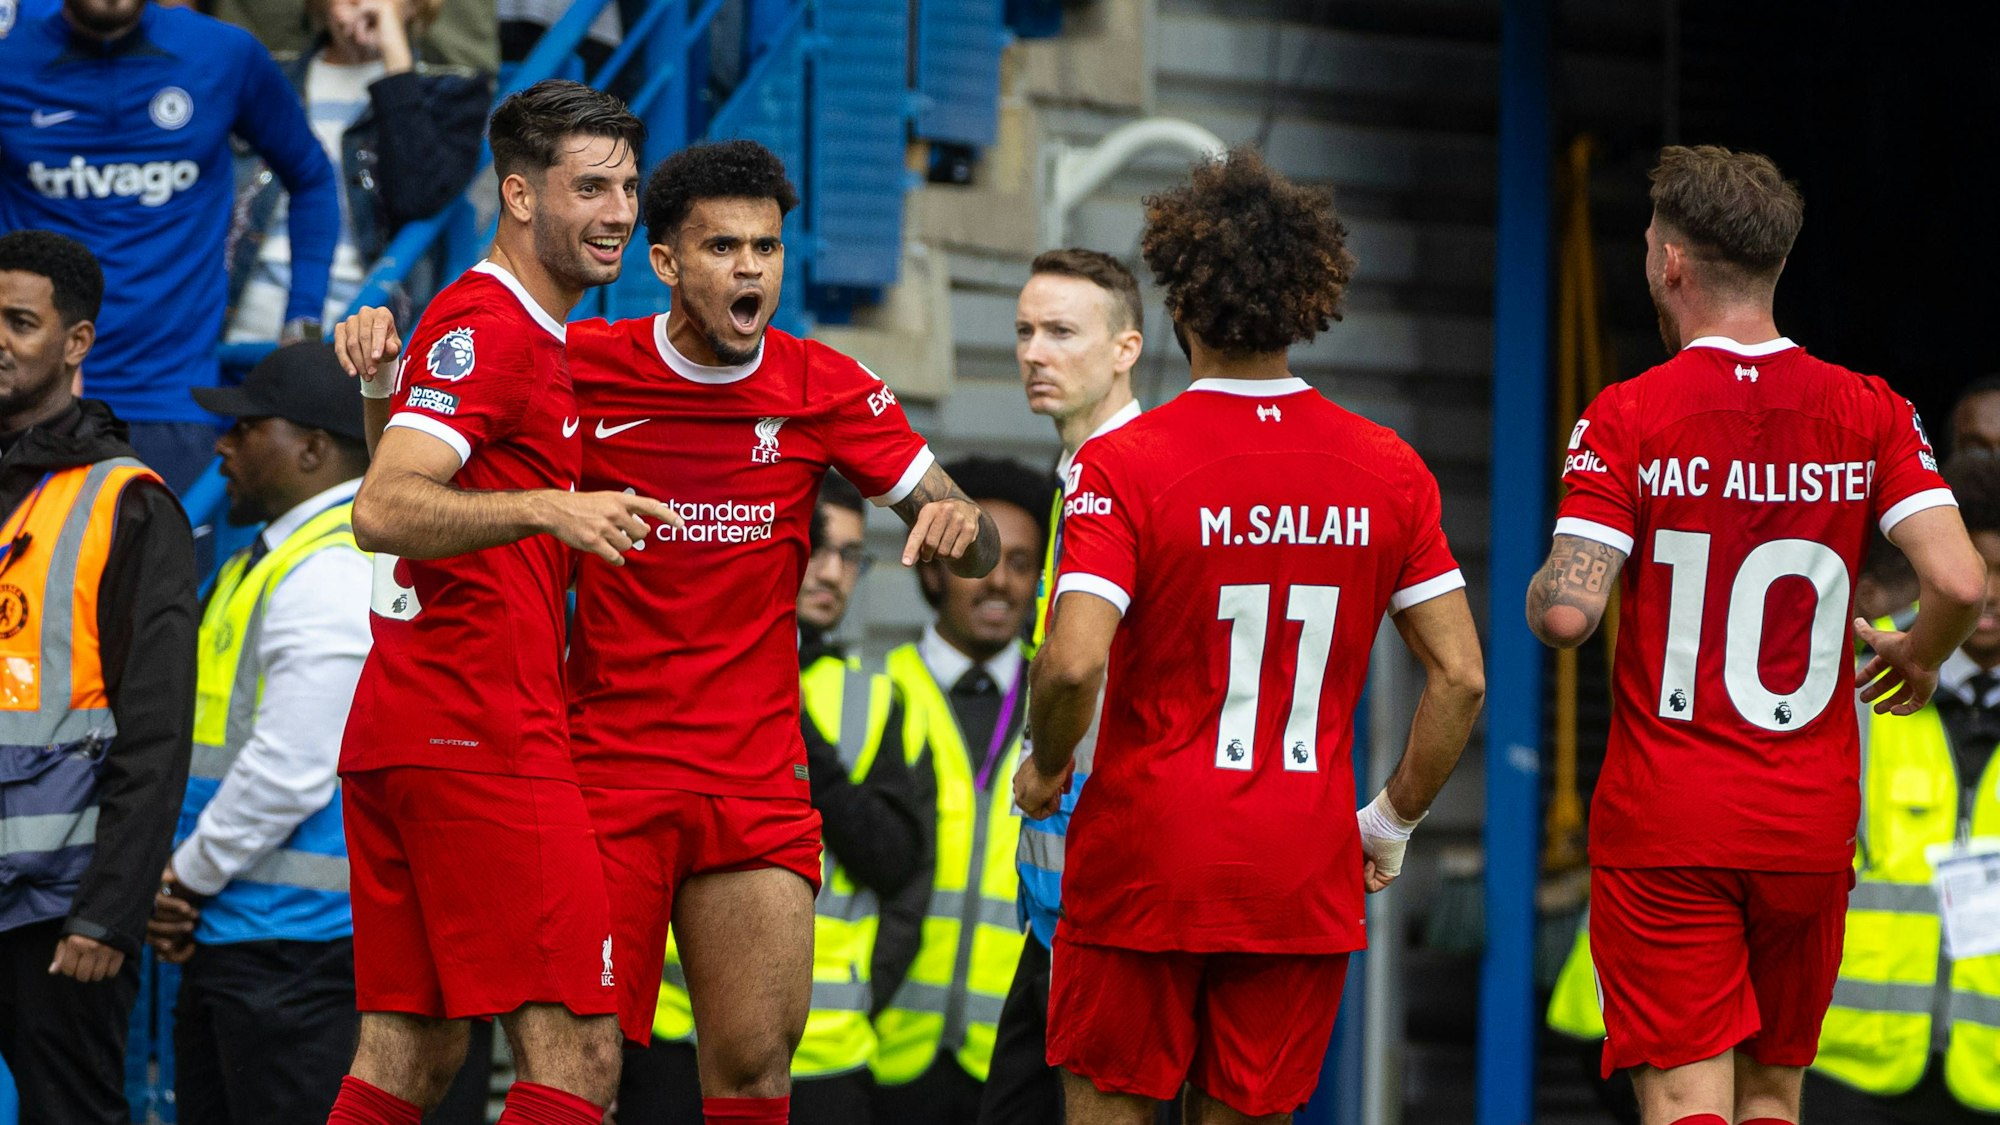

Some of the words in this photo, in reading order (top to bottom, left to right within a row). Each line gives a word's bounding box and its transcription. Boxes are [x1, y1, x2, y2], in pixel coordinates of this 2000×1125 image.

[28, 155, 199, 207] trivago
[418, 397, 456, 416] racism
[422, 389, 454, 406] room
[1638, 456, 1710, 498] MAC
[656, 521, 773, 543] chartered
[1200, 505, 1369, 547] M.SALAH
[1568, 551, 1607, 593] 28
[1653, 529, 1851, 732] 10
[1215, 584, 1340, 772] 11
